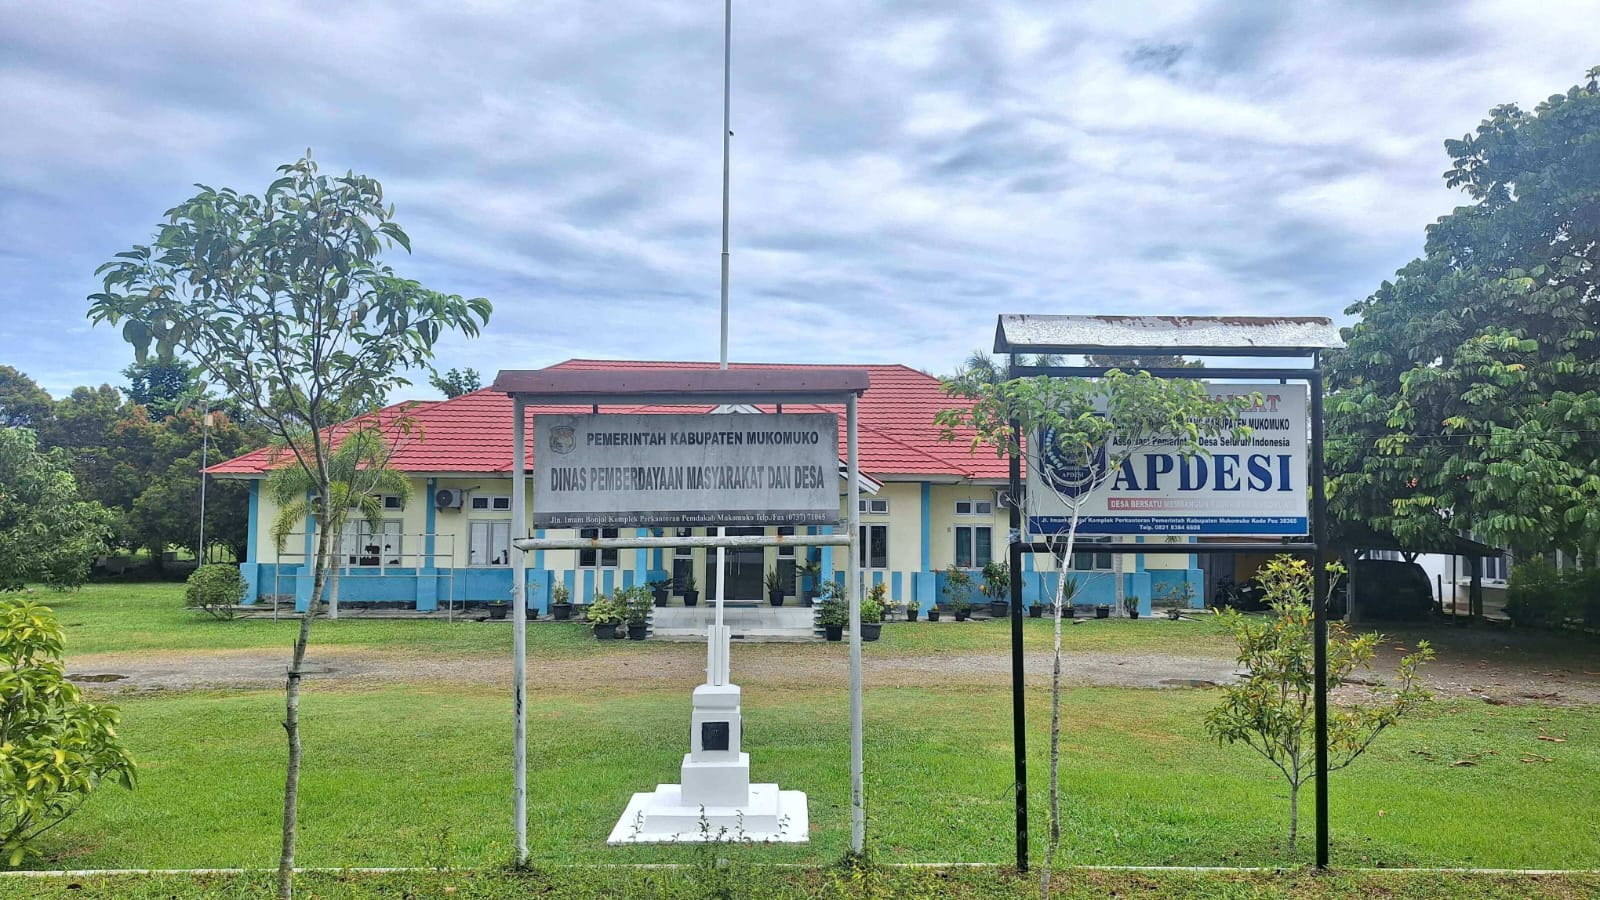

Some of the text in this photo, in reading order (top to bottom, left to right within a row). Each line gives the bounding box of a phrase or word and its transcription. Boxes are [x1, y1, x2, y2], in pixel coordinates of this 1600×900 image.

[1249, 418, 1290, 431] MUKOMUKO
[586, 431, 819, 446] PEMERINTAH KABUPATEN MUKOMUKO
[1199, 436, 1218, 447] Desa
[1252, 436, 1290, 447] Indonesia
[550, 465, 825, 492] DINAS PEMBERDAYAAN MASYARAKAT DAN DESA
[1110, 453, 1293, 492] APDESI
[1111, 500, 1129, 508] DESA
